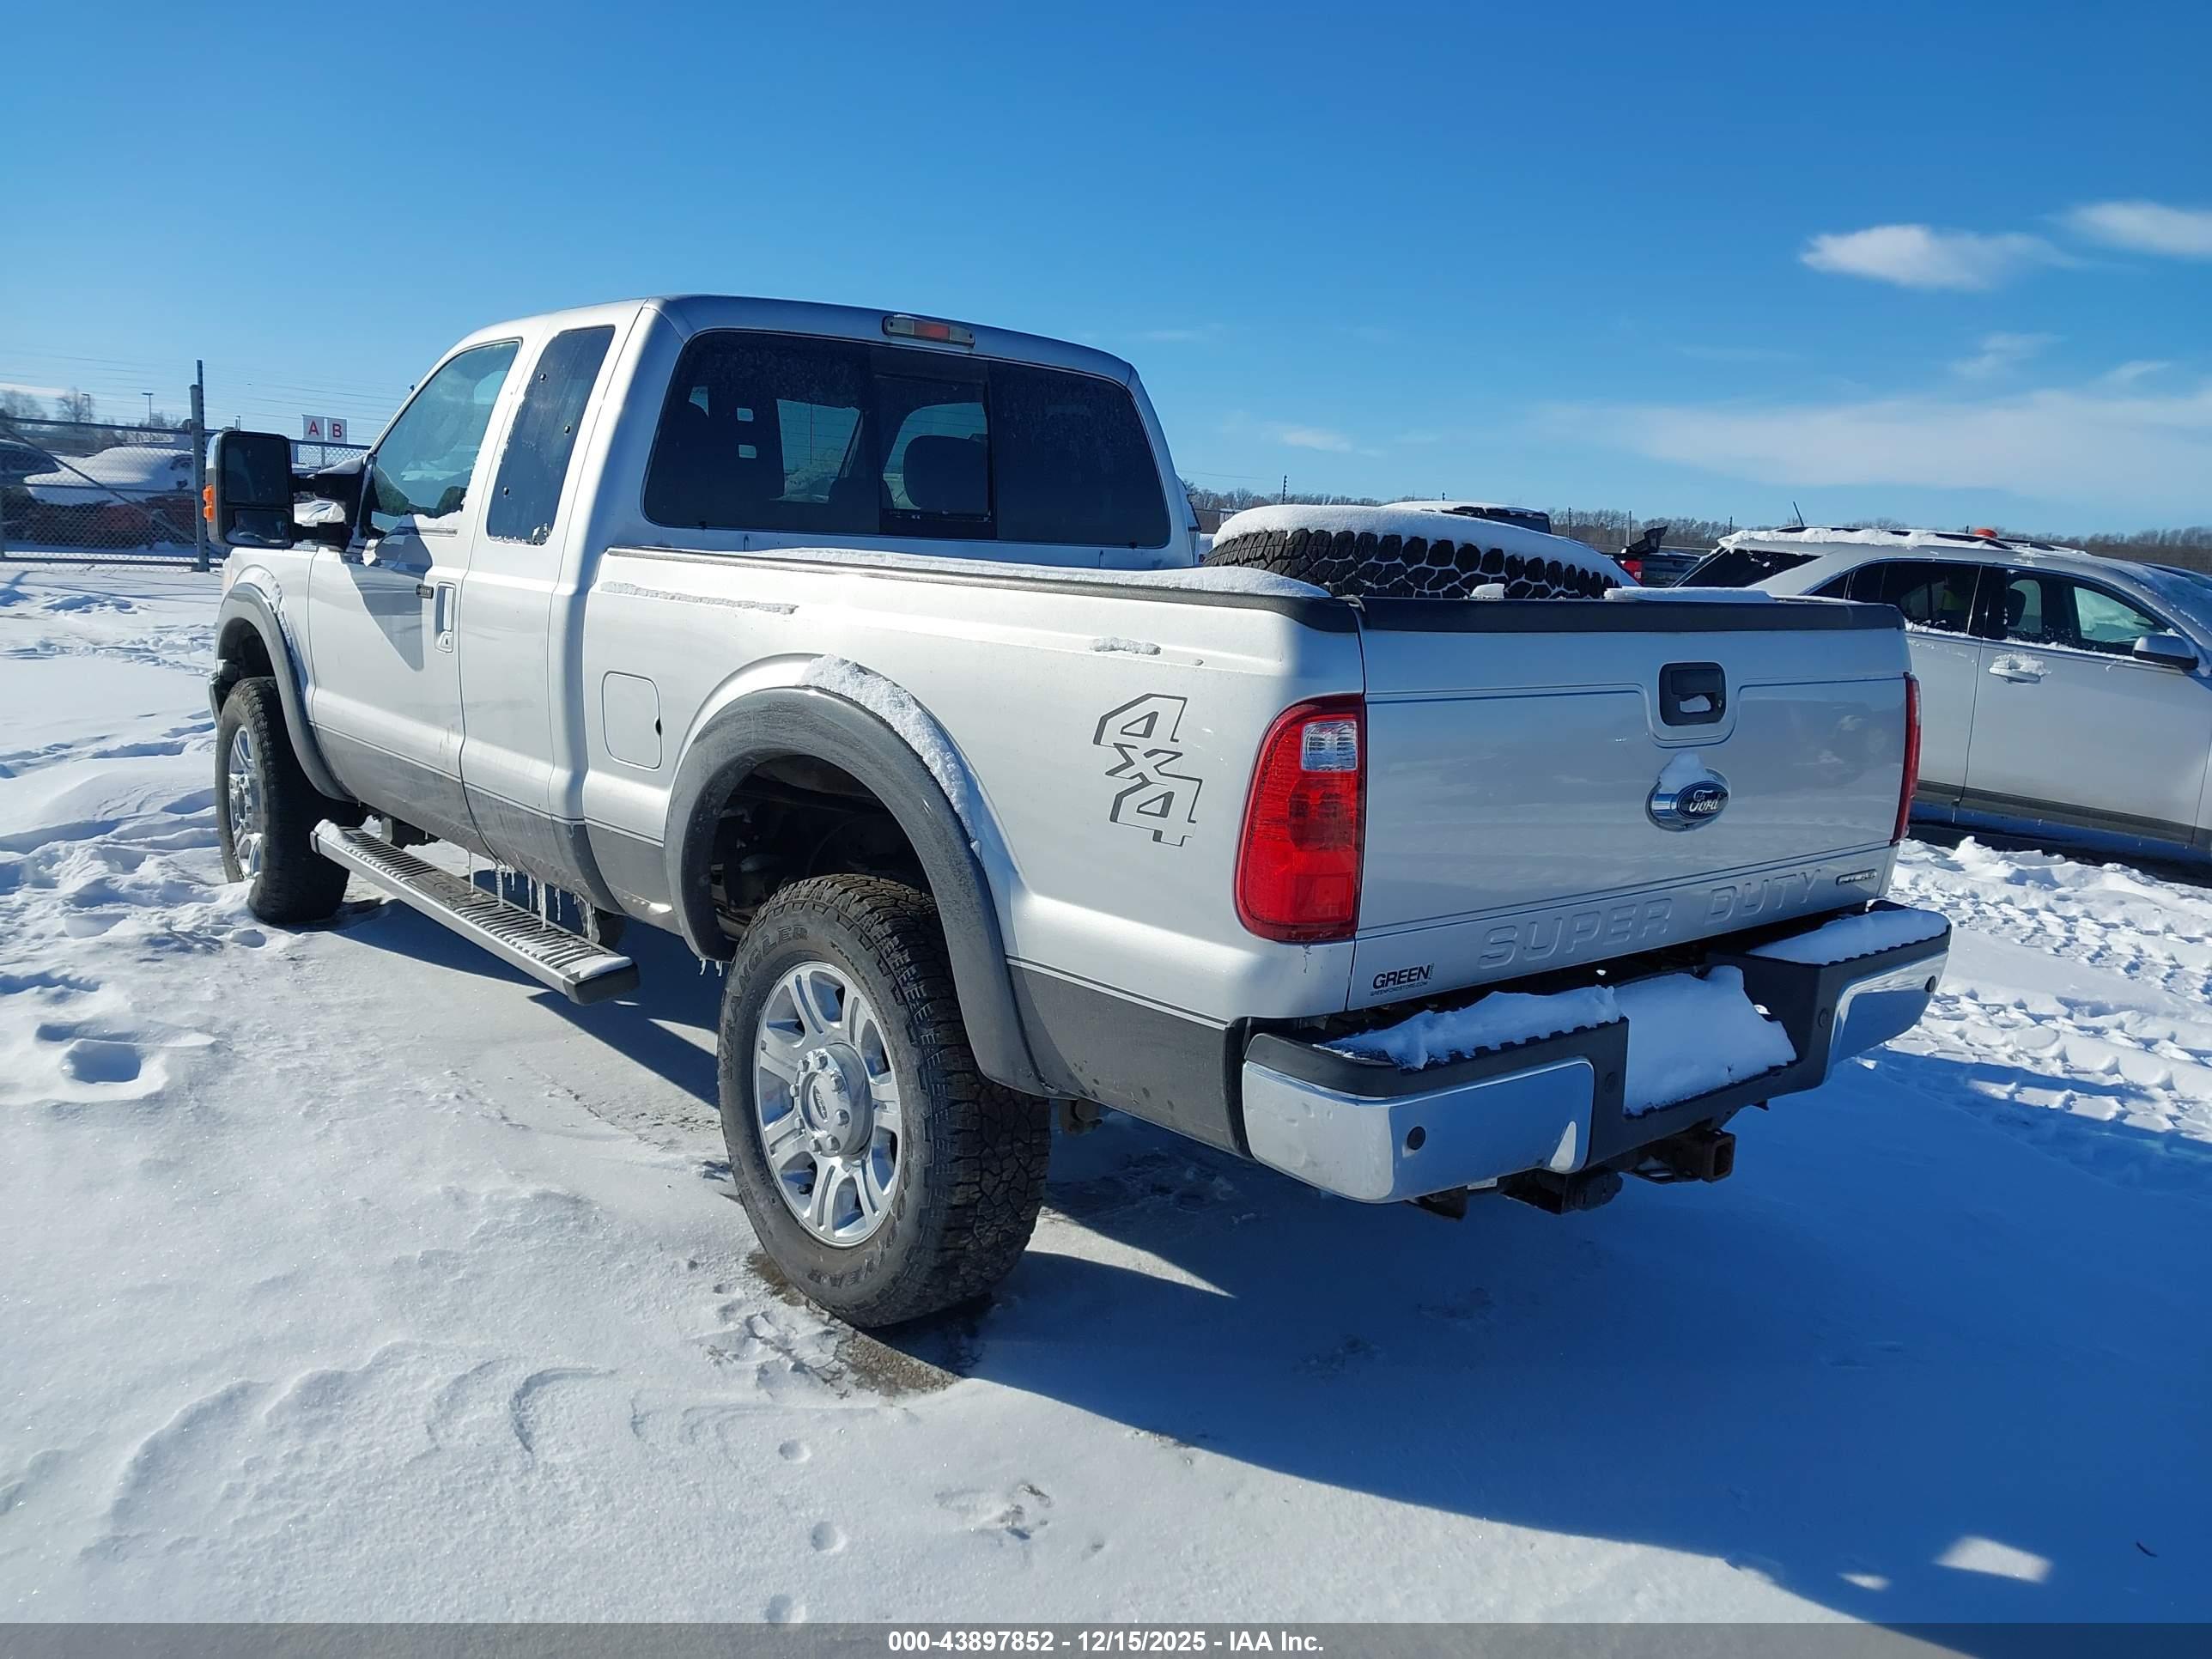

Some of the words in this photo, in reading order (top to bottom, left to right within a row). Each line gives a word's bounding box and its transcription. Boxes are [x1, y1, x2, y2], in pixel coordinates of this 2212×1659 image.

[308, 421, 319, 435] A
[332, 423, 342, 438] B
[1688, 789, 1723, 812] Ford
[1478, 897, 1674, 971] SUPER
[1704, 868, 1821, 927] DUTY
[1372, 964, 1431, 989] GREEN
